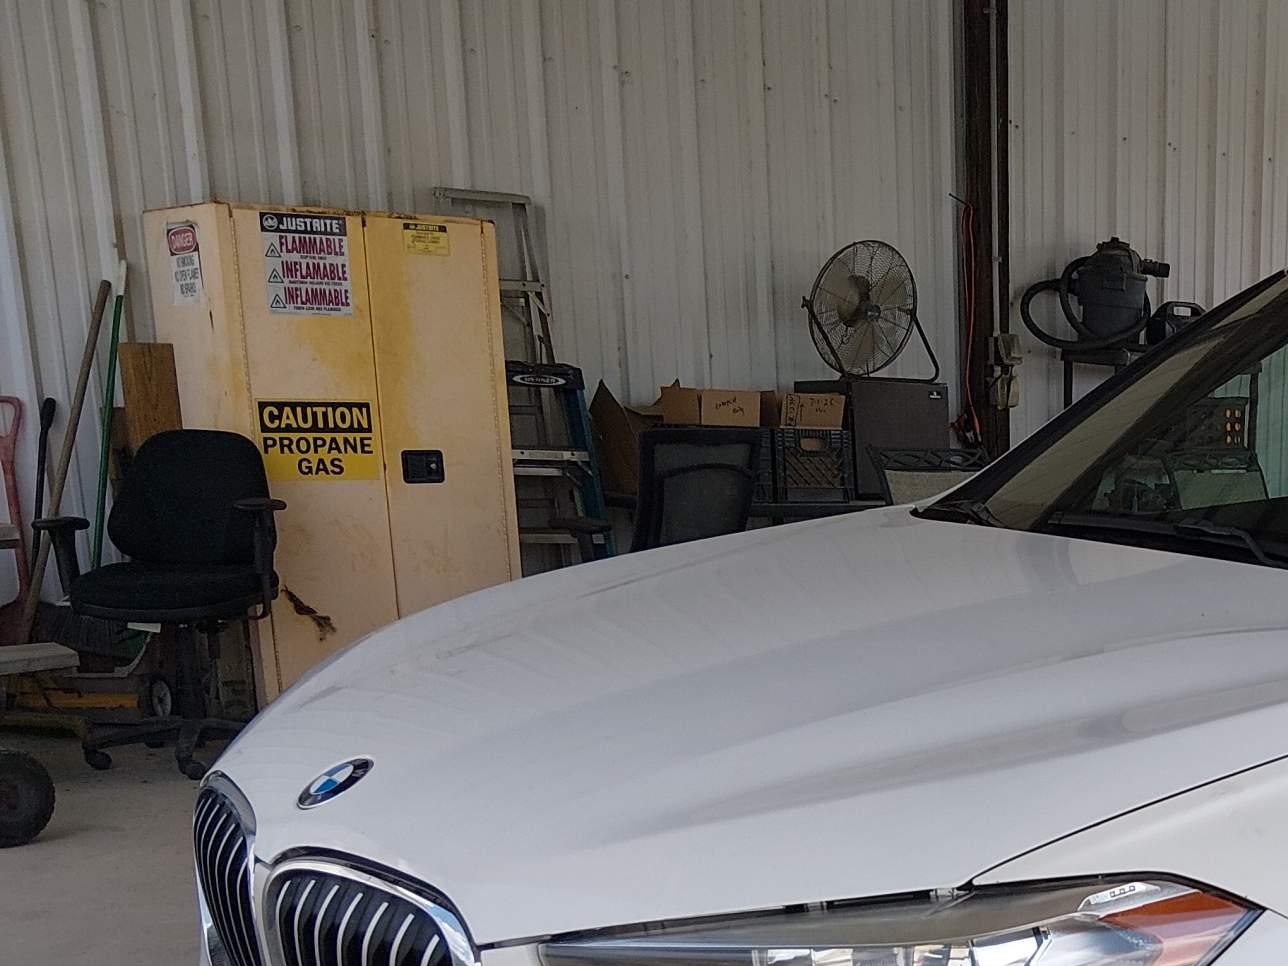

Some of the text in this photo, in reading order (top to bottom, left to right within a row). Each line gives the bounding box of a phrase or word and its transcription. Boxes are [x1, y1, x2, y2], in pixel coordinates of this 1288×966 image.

[279, 215, 340, 232] JUSTRITE
[279, 235, 344, 256] FLAMMABLE
[281, 260, 348, 282] INFLAMABLE
[284, 286, 350, 307] INFLAMMABLE
[263, 406, 369, 430] CAUTION
[263, 436, 374, 455] PROPANE
[297, 458, 345, 476] GAS
